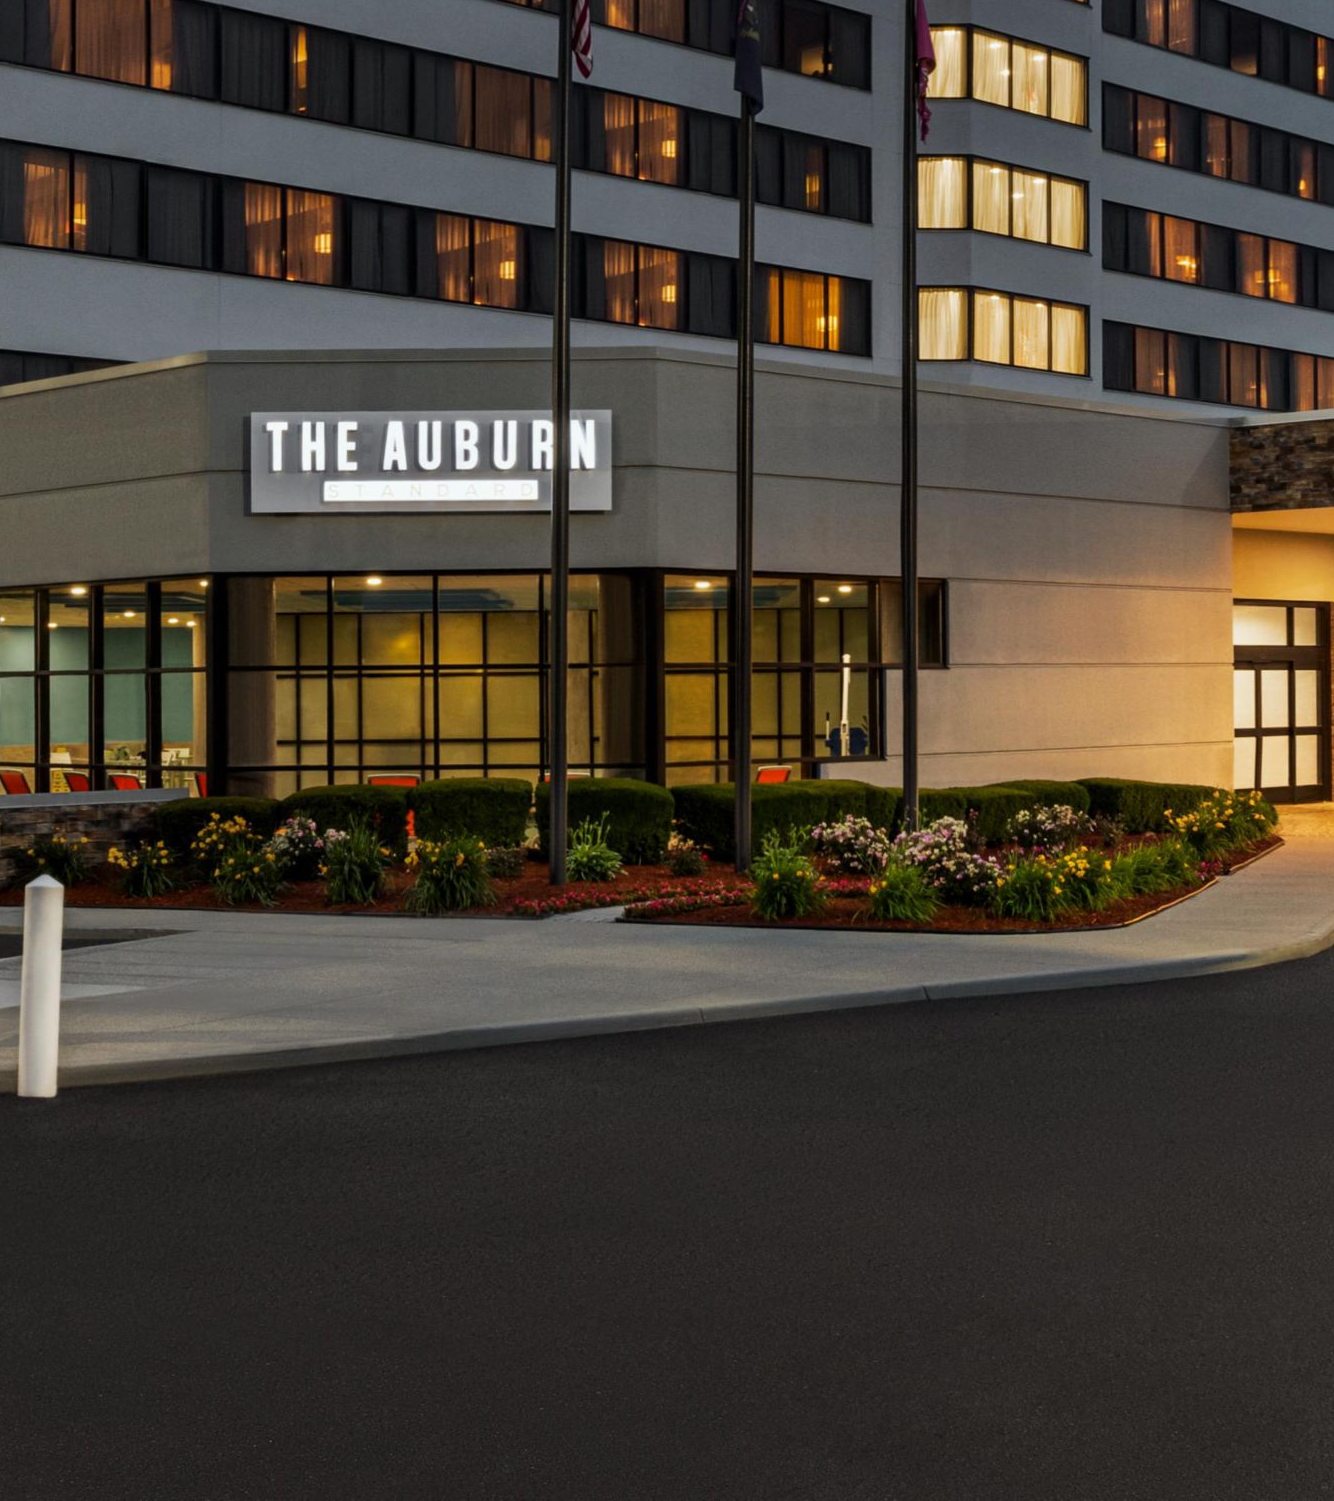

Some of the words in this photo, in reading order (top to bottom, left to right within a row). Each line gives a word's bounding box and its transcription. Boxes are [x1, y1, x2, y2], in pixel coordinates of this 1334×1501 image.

[266, 420, 358, 471] THE
[383, 419, 596, 470] AUBURN
[327, 483, 534, 499] STANDARD
